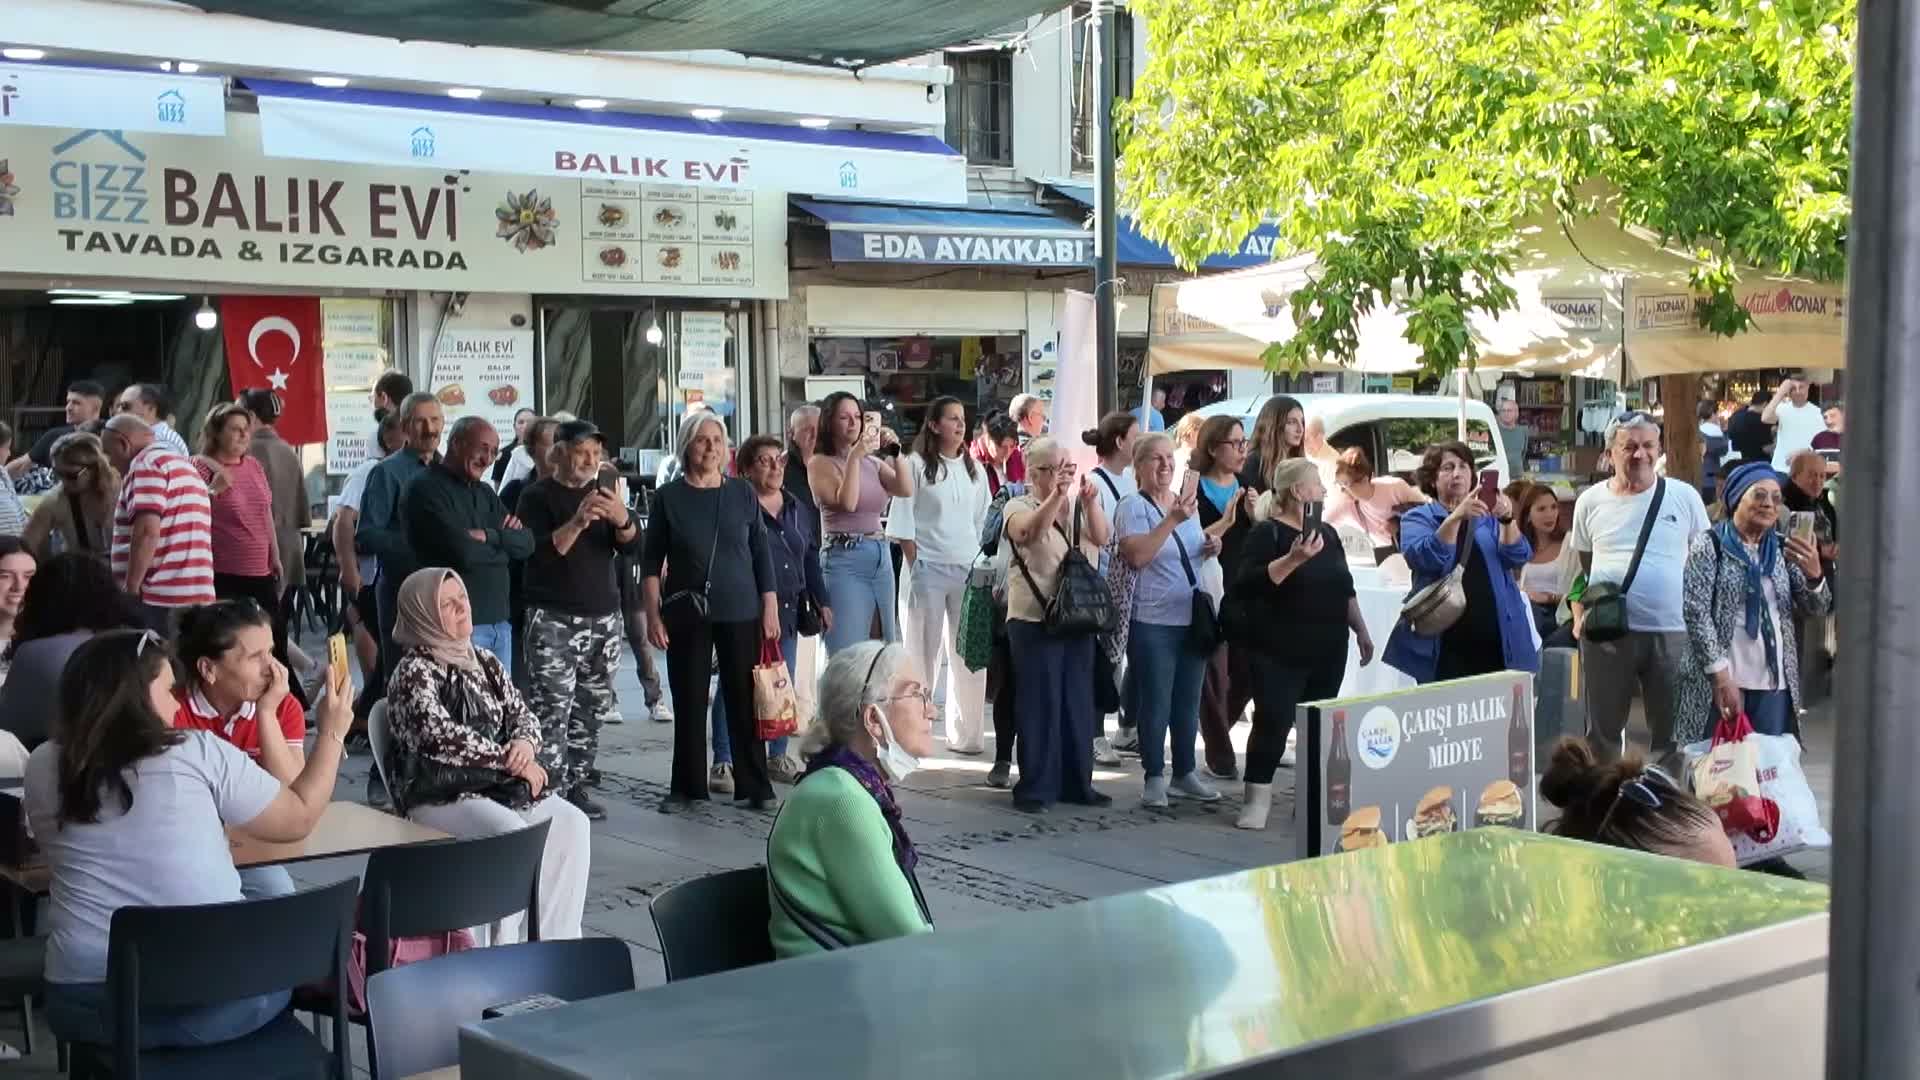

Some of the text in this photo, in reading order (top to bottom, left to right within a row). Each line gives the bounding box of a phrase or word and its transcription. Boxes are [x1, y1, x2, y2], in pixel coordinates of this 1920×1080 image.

[50, 161, 148, 194] CIZZ
[555, 151, 670, 178] BALIK
[53, 191, 150, 224] BIZZ
[164, 168, 459, 242] BALIK EVİ
[58, 229, 468, 270] TAVADA & IZGARADA
[863, 233, 1084, 263] EDA AYAKKABI
[1550, 302, 1597, 315] KONAK
[1656, 299, 1686, 313] KONAK
[456, 340, 490, 353] BALIK
[1402, 696, 1507, 742] ÇARŞI BALIK
[1429, 737, 1483, 769] MİDYE
